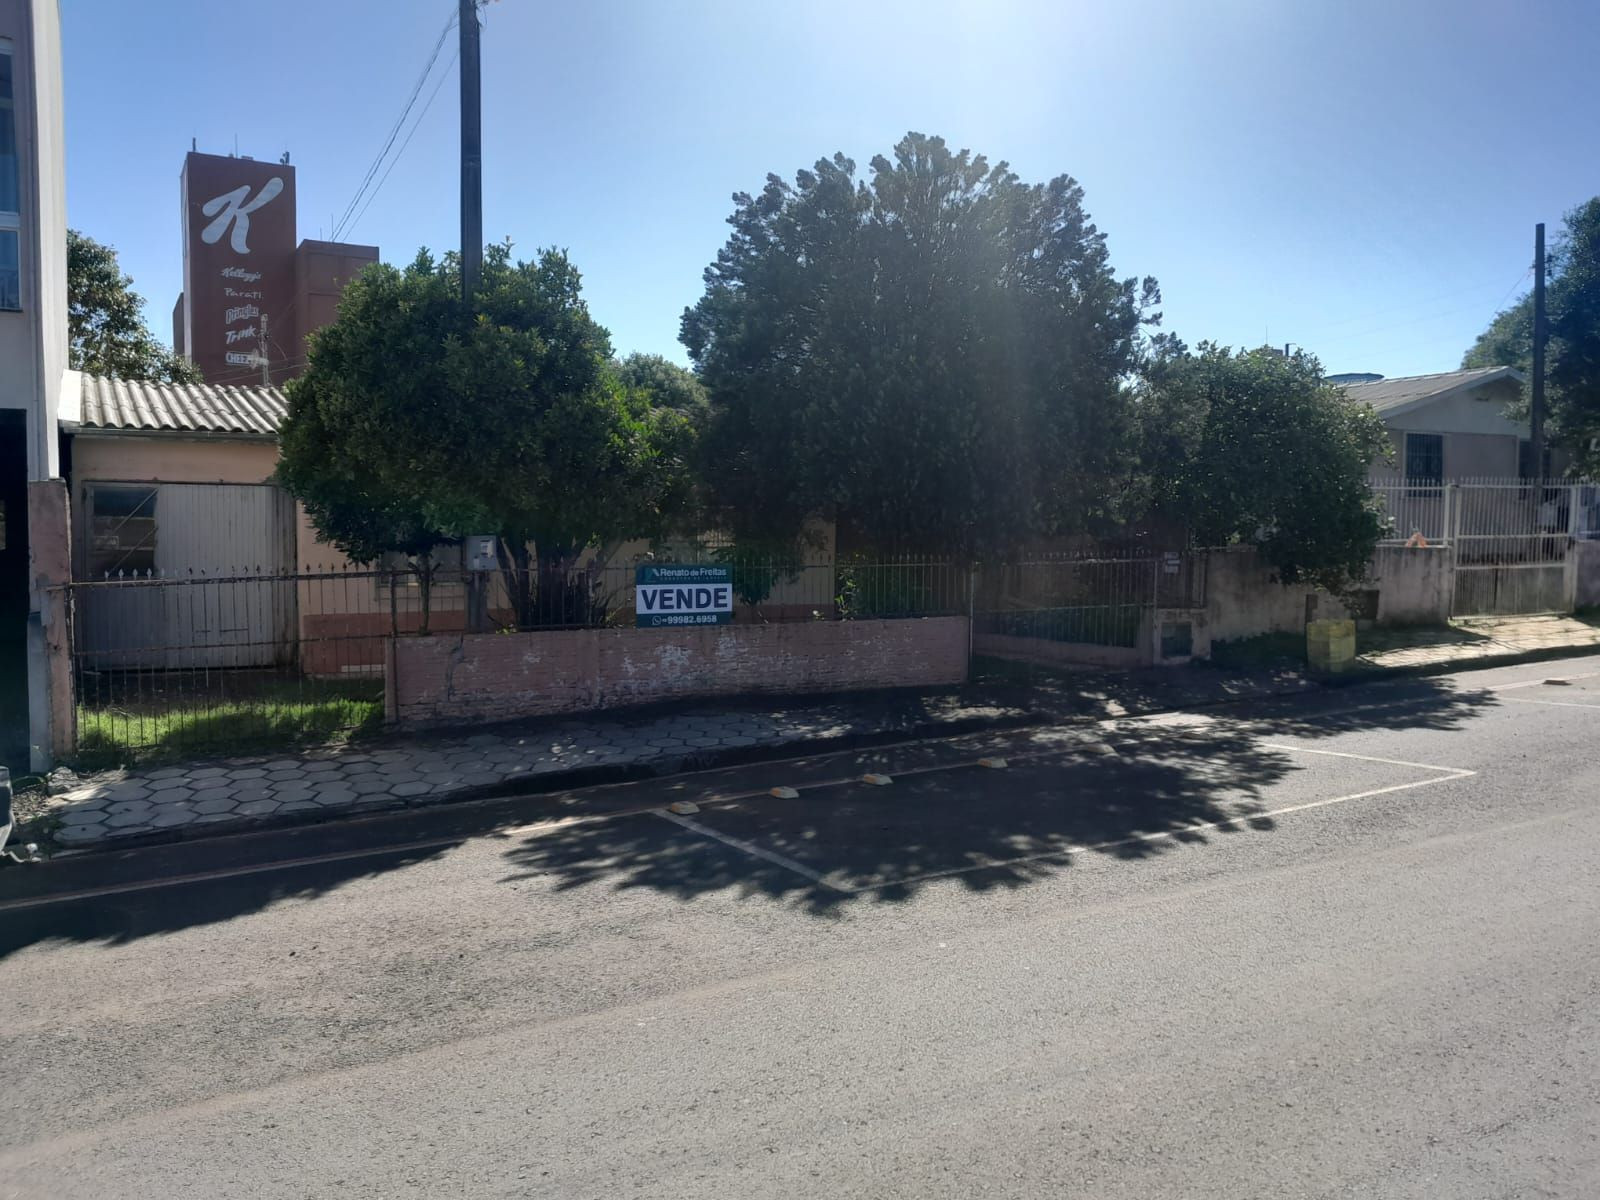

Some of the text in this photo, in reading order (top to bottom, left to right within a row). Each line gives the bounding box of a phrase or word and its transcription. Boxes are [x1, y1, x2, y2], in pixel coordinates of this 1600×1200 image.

[202, 177, 284, 254] K
[225, 304, 259, 324] Pringles
[660, 568, 689, 577] Renato
[700, 567, 727, 576] Freitas
[641, 588, 728, 610] VENDE
